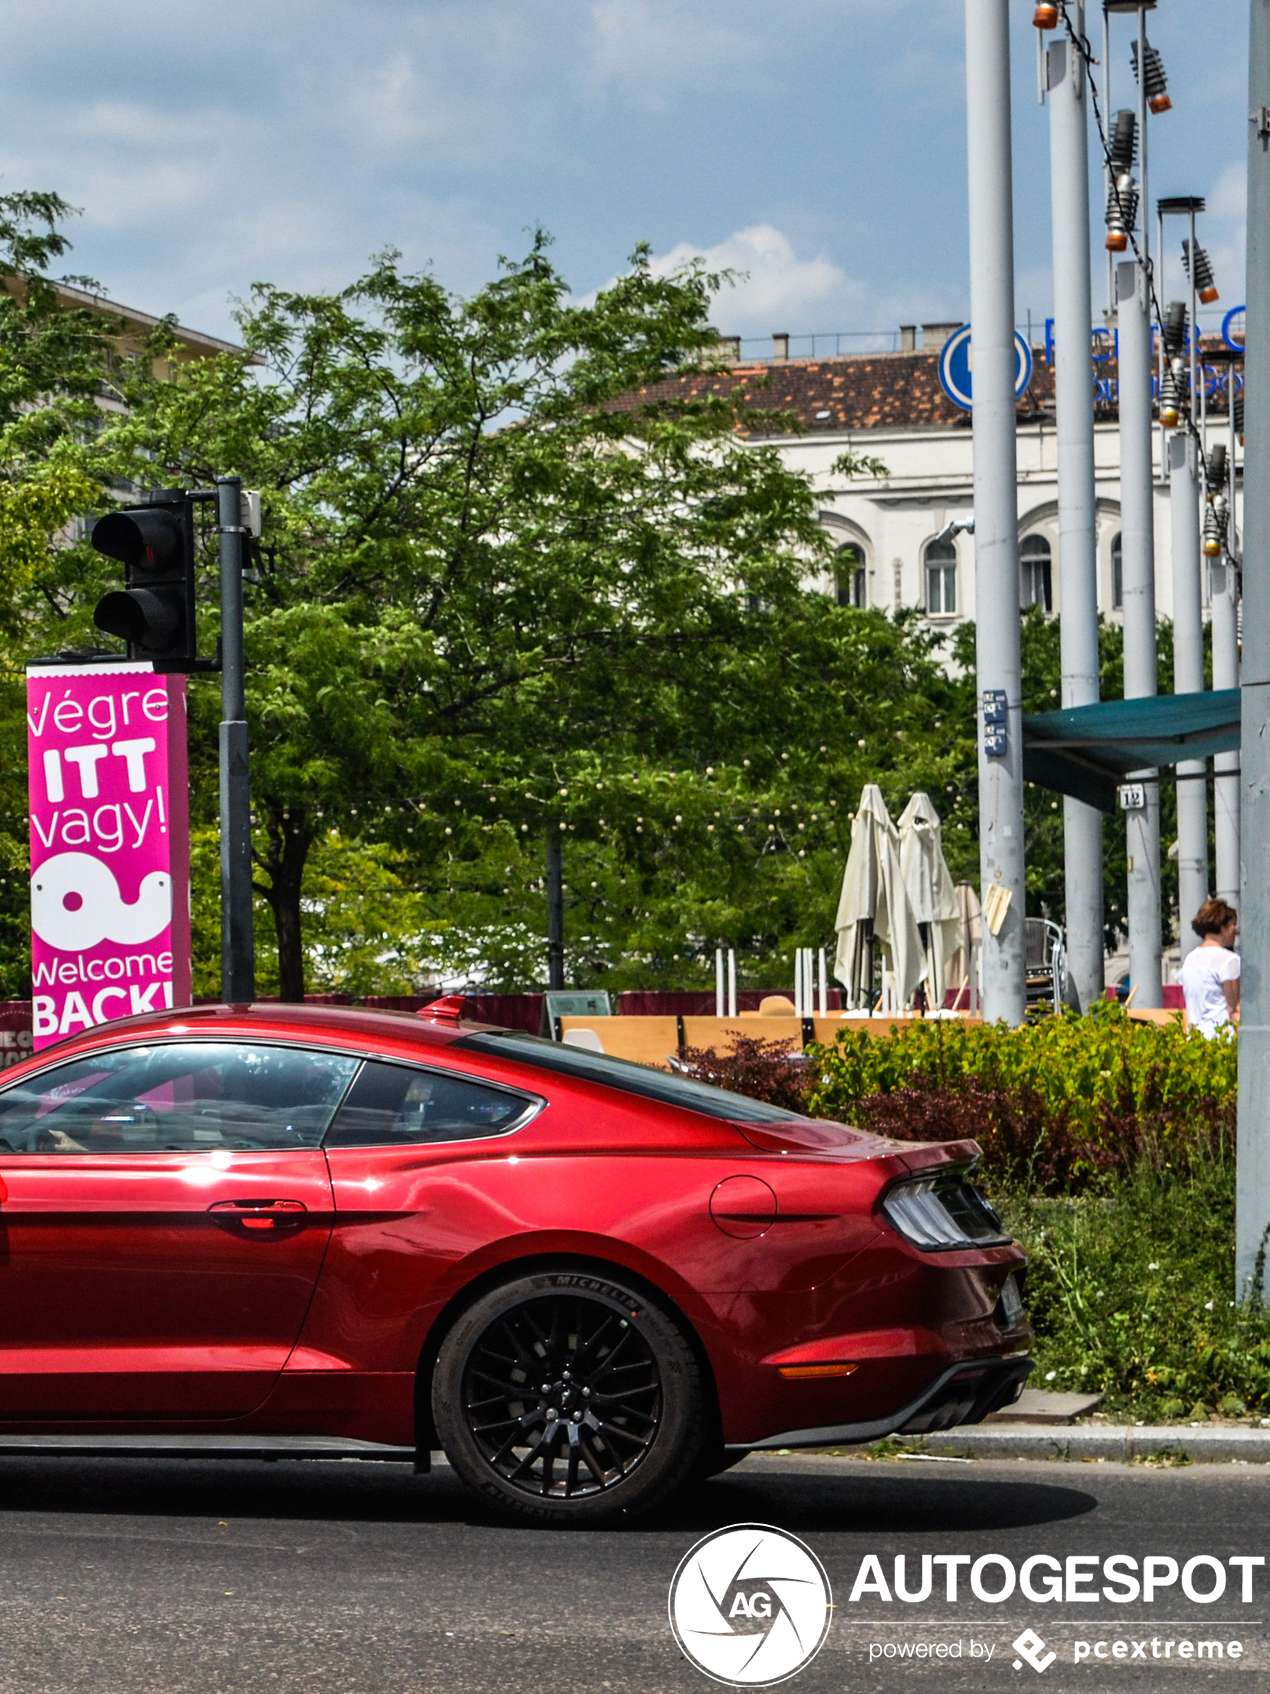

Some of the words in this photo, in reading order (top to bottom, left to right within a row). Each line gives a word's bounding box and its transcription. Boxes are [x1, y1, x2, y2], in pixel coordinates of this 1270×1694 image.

[27, 689, 168, 740] Végre
[42, 737, 156, 803] ITT
[31, 785, 167, 853] vagy!
[1124, 792, 1140, 806] 12
[32, 952, 173, 987] Welcome
[556, 1276, 638, 1309] MICHELIN
